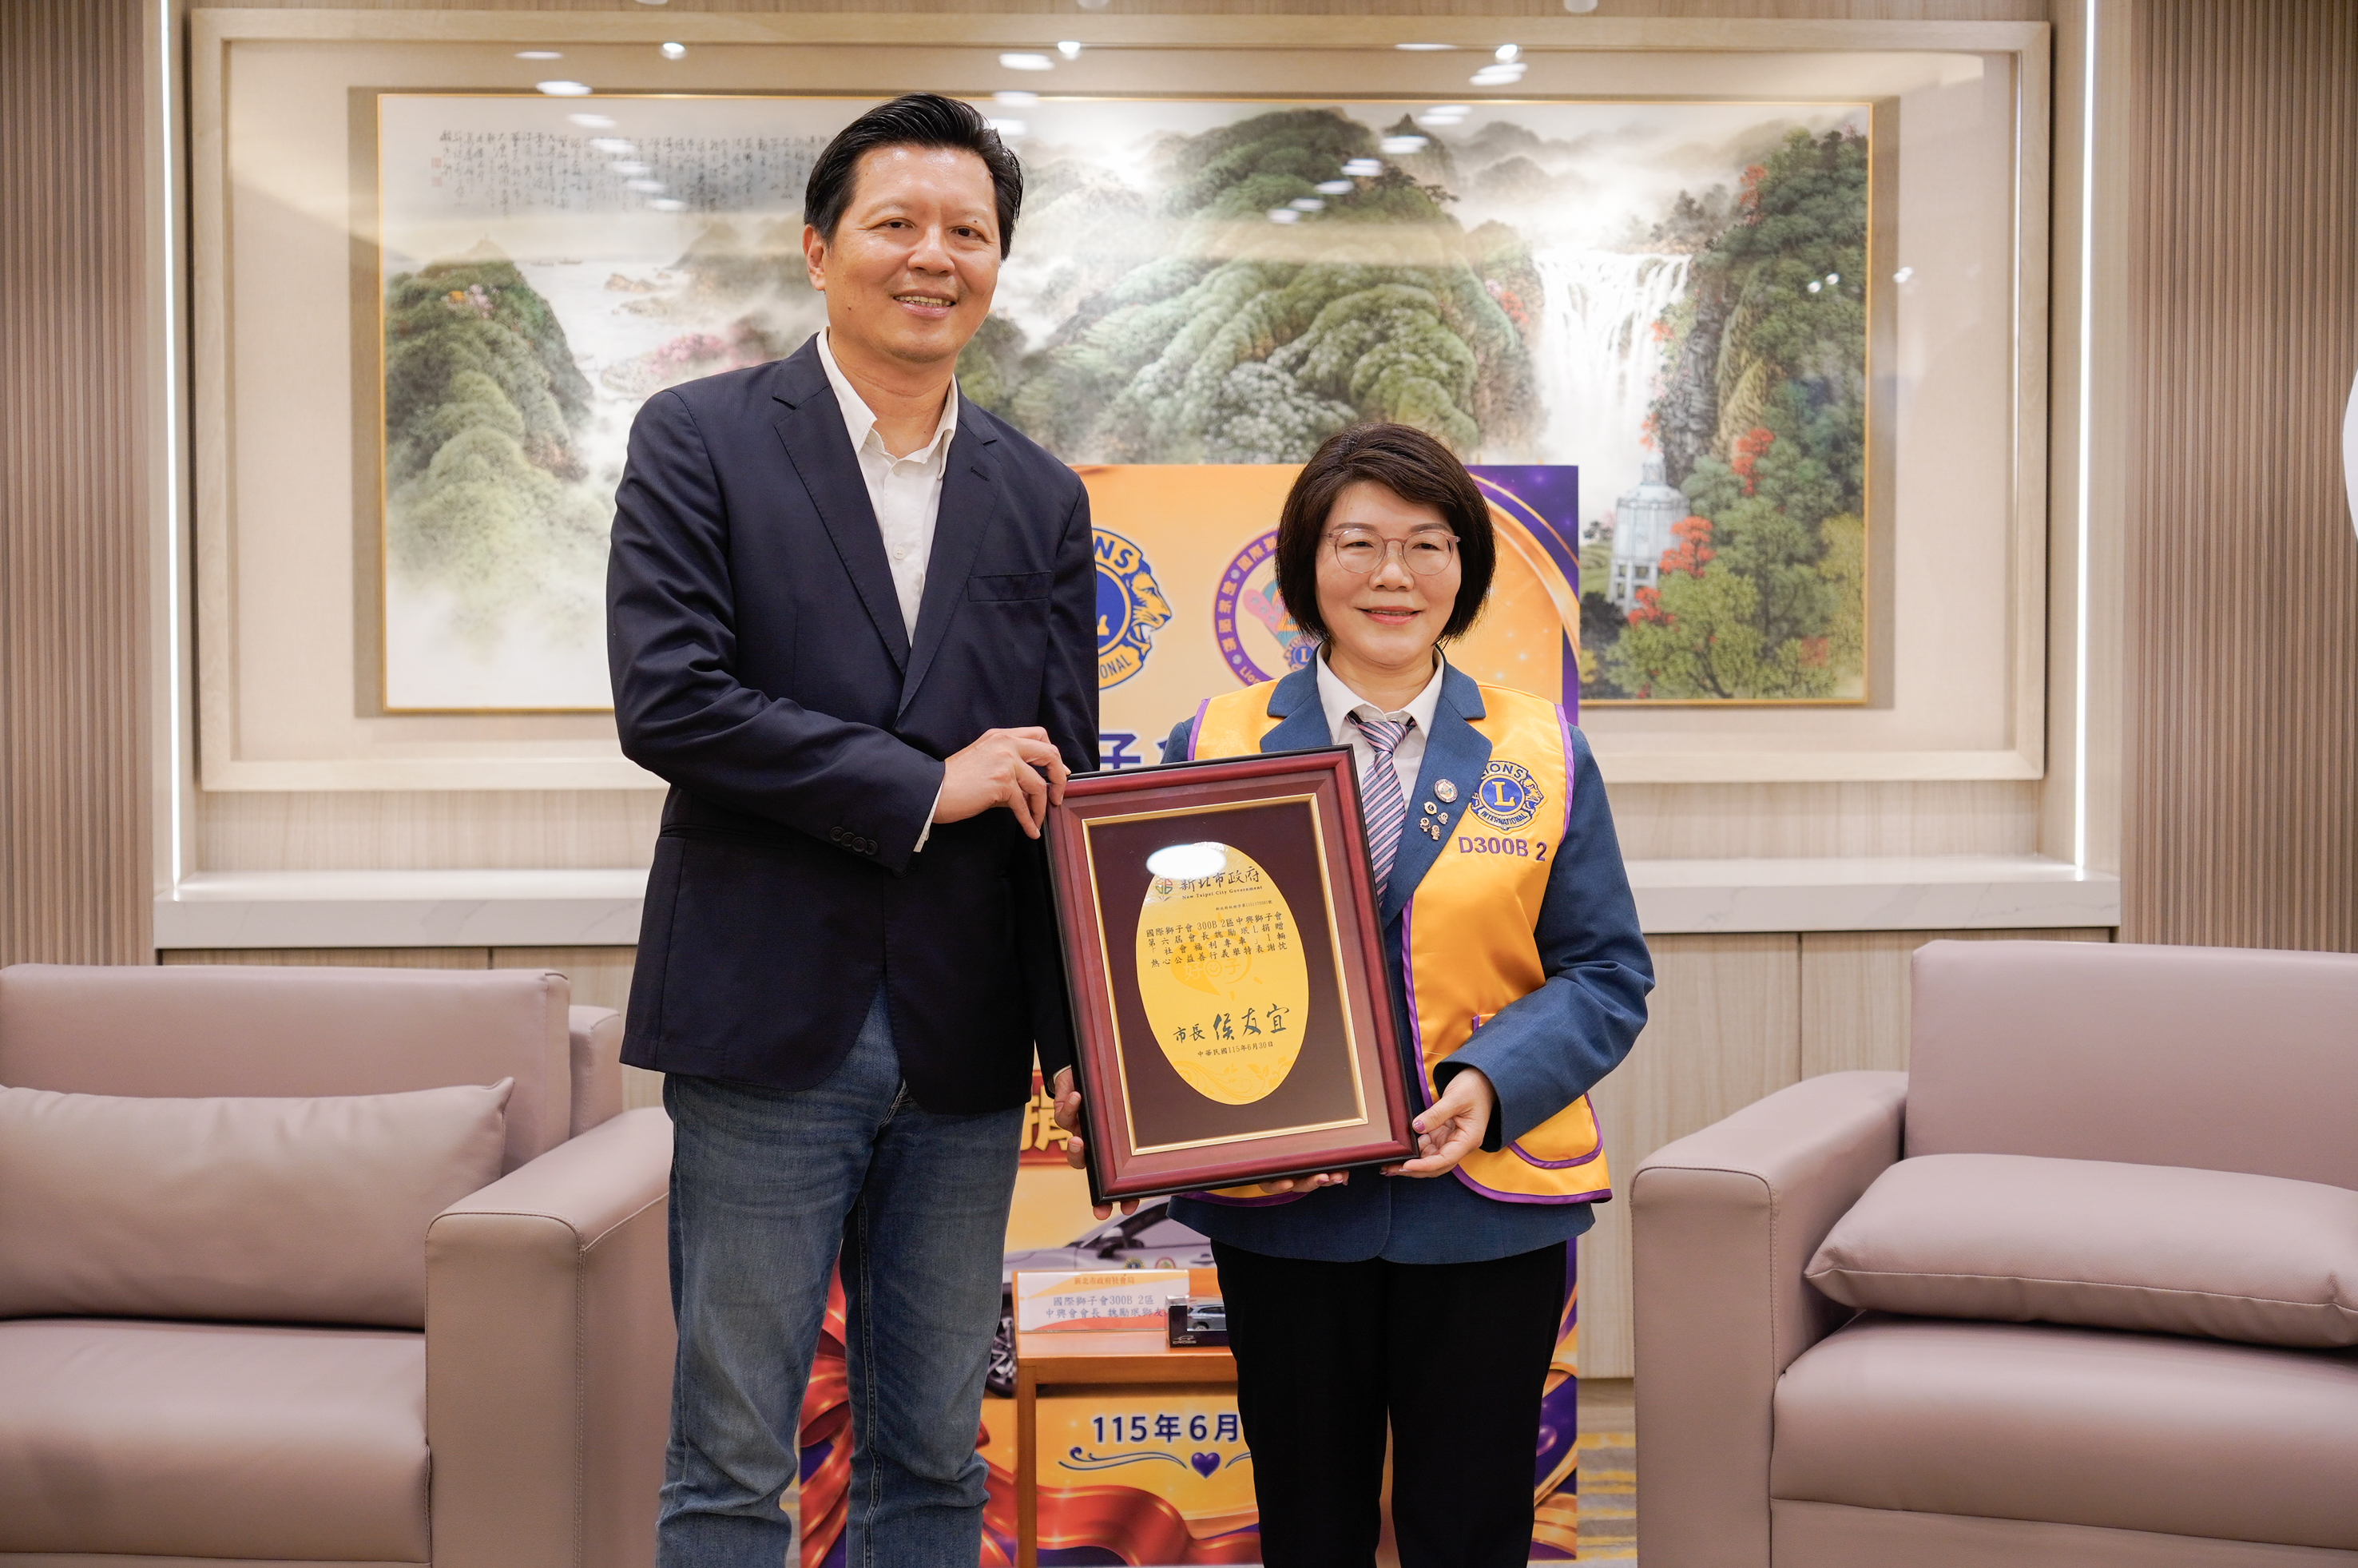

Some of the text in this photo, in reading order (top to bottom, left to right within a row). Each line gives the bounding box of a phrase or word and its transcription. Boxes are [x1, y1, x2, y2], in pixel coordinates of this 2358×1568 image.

[1484, 764, 1523, 778] ONS
[1492, 781, 1515, 806] L
[1481, 811, 1528, 825] INTERNATIONAL
[1459, 836, 1547, 862] D300B 2
[1179, 867, 1260, 892] 新北市政府
[1229, 885, 1263, 894] Government
[1146, 923, 1193, 939] 國際獅子會
[1197, 919, 1217, 931] 300B
[1173, 1002, 1289, 1043] 市長 侯友宜
[1197, 1041, 1273, 1058] 中華民國115年6月30日
[1046, 1308, 1101, 1319] 中興會會長
[1092, 1414, 1238, 1443] 115年6月
